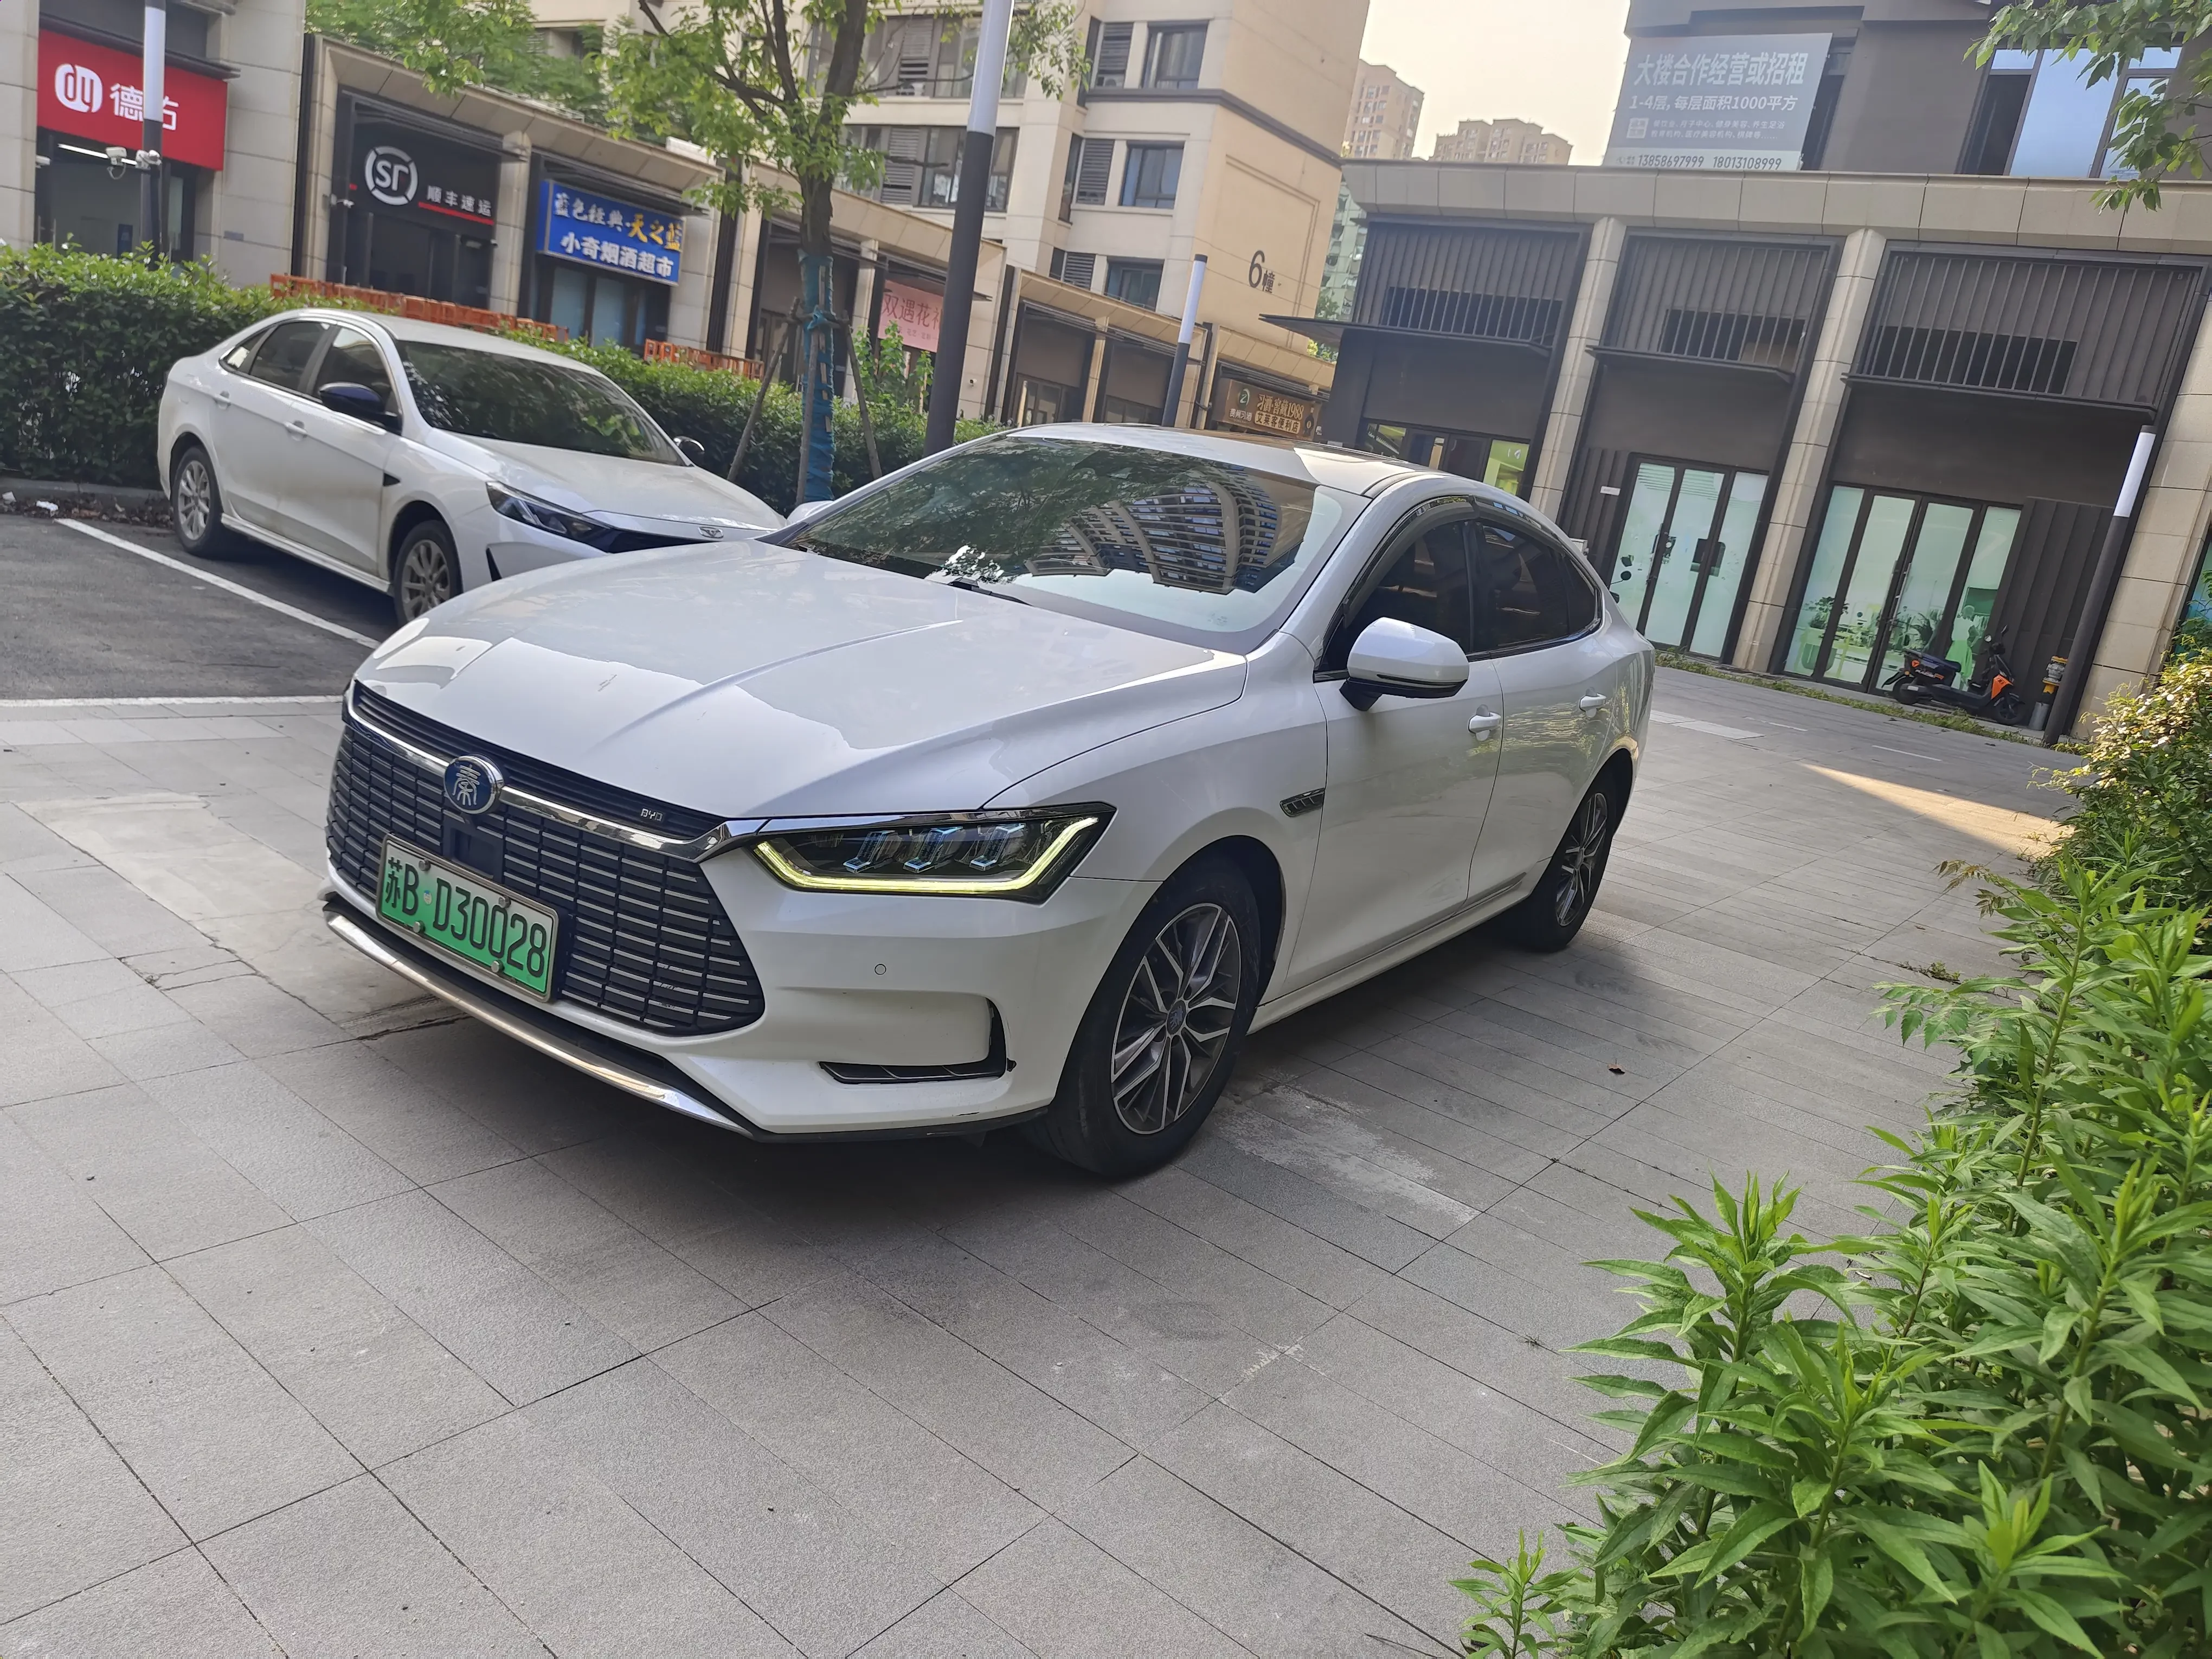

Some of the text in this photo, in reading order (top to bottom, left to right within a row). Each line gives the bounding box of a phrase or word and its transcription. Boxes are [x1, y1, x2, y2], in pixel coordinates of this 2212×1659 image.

[1633, 52, 1809, 86] 大楼合作经营或招租
[1638, 154, 1705, 168] 13858697999
[1713, 156, 1782, 170] 18013108999
[426, 185, 492, 217] 顺丰速运
[560, 231, 674, 278] 小奇烟酒超市
[640, 808, 663, 822] BYD
